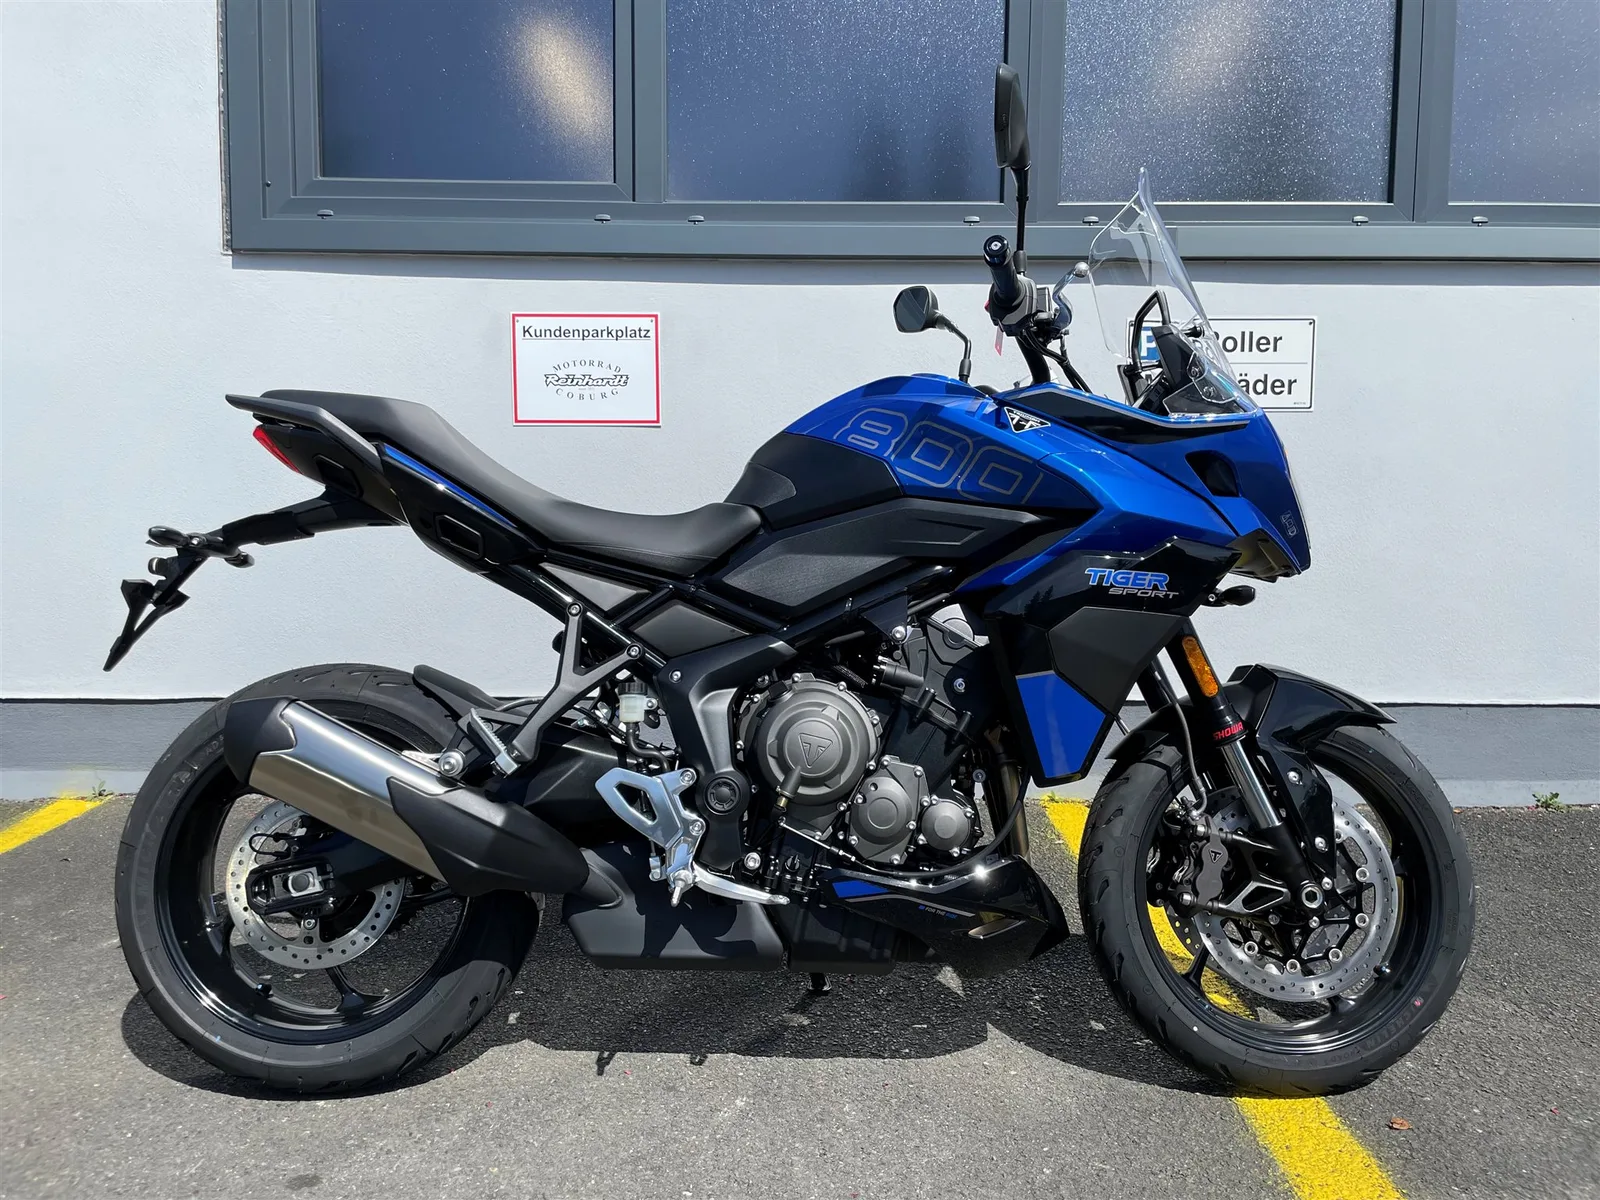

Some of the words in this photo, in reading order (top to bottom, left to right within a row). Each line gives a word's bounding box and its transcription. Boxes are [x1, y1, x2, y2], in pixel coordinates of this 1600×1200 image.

[522, 325, 651, 341] Kundenparkplatz
[1213, 331, 1283, 353] oller
[552, 359, 622, 374] MOTORRAD
[544, 374, 630, 387] Reinhardt
[555, 388, 619, 401] COBURG
[833, 408, 1043, 504] 800
[1085, 567, 1169, 591] TIGER
[1108, 588, 1178, 599] SPORT
[1212, 722, 1244, 740] SHOWA
